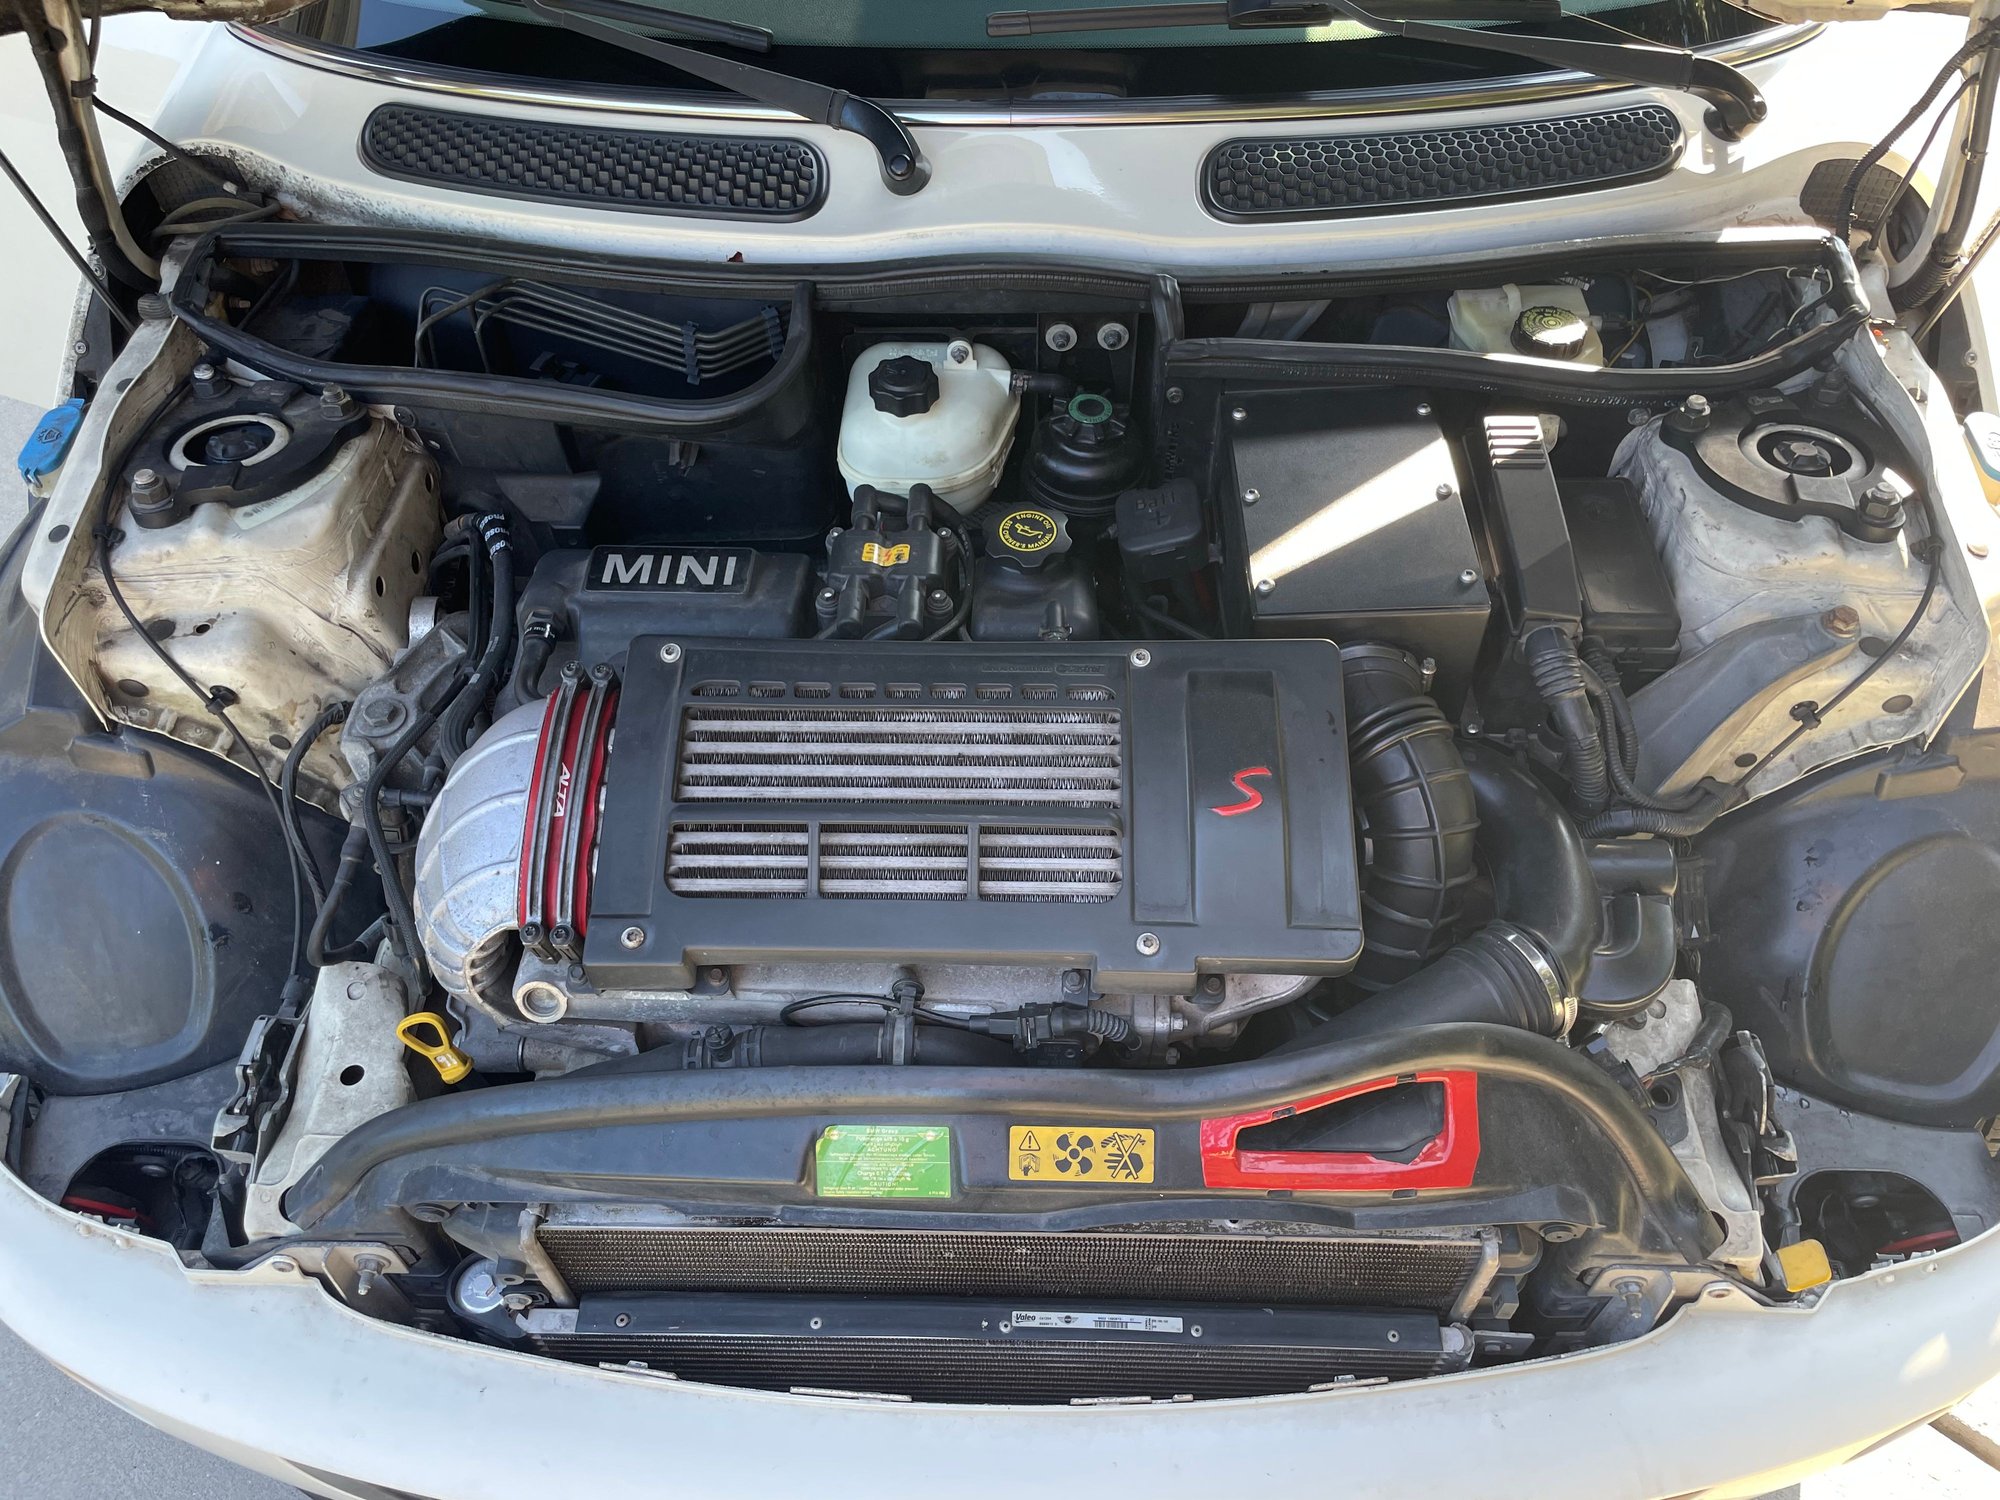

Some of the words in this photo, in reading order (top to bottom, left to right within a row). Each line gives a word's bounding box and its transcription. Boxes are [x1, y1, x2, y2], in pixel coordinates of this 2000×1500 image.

[1003, 519, 1013, 529] SEE
[1016, 513, 1044, 522] ENGINE
[1043, 520, 1052, 529] OIL
[1002, 530, 1026, 549] OWNER'S
[1027, 533, 1053, 549] MANUAL
[601, 553, 737, 586] MINI
[553, 762, 571, 818] ALTA
[1209, 765, 1273, 818] S
[1015, 1313, 1036, 1322] Valeo
